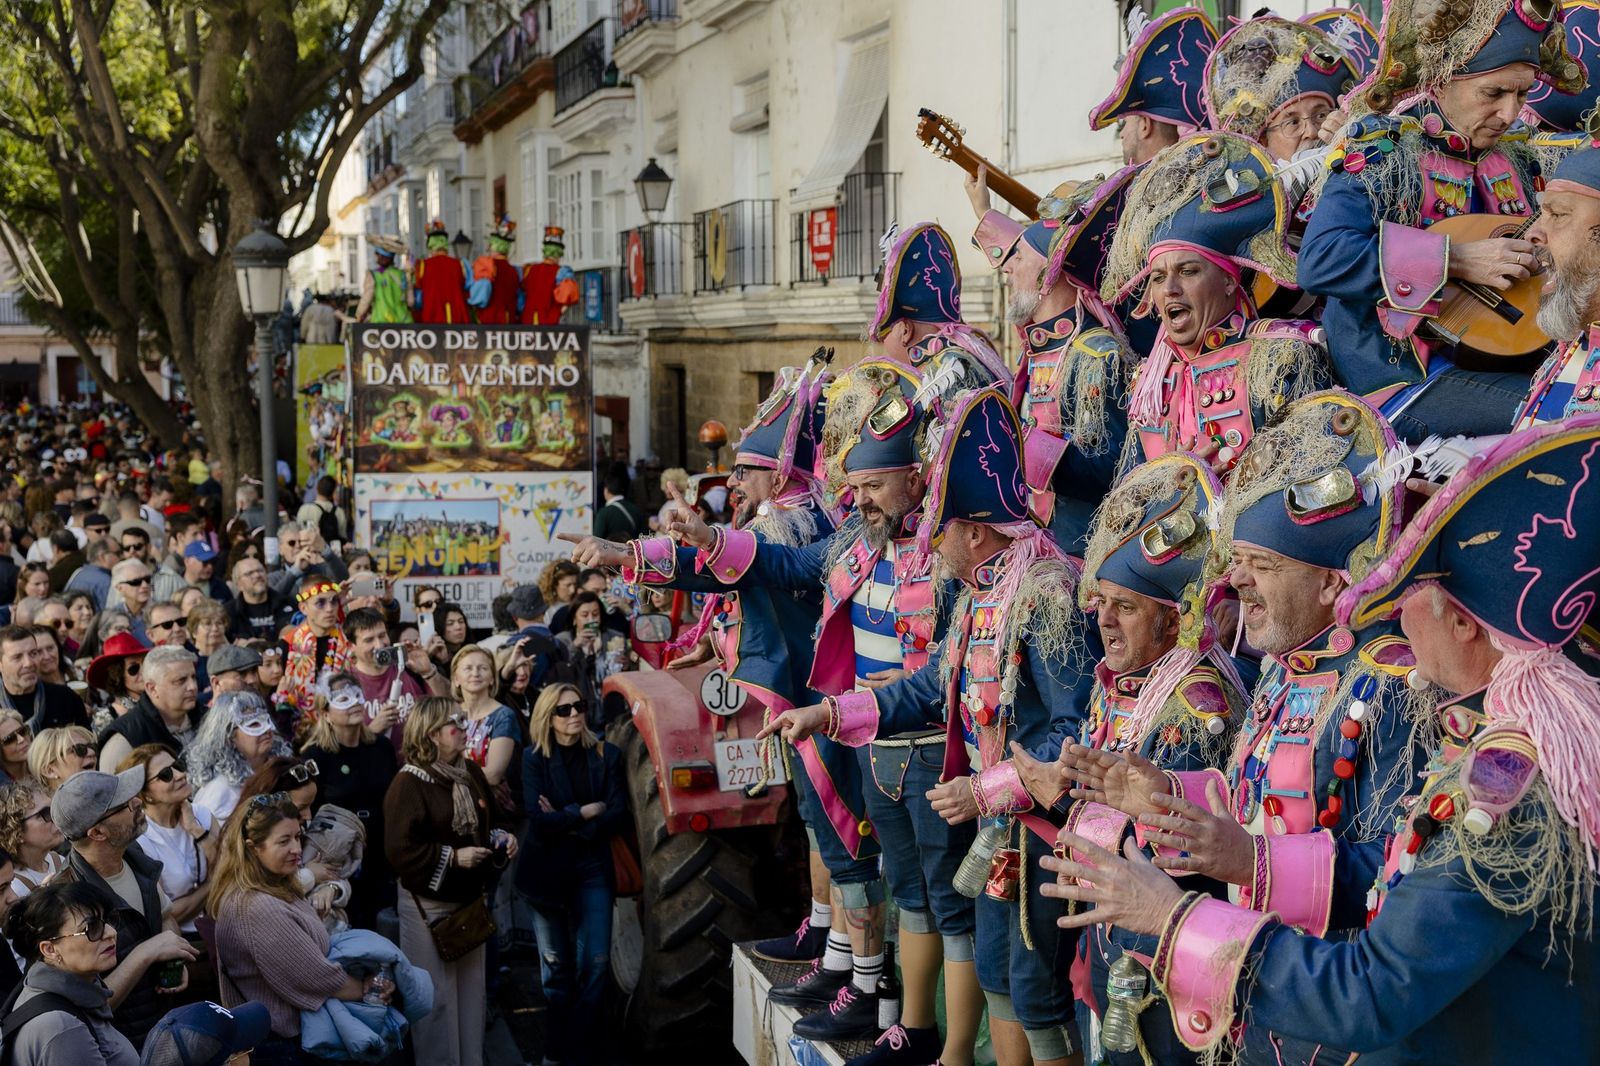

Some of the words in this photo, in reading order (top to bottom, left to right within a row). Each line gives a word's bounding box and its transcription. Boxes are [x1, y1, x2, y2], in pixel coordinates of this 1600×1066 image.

[362, 329, 437, 350] CORO
[445, 330, 479, 350] DE
[486, 331, 581, 351] HUELVA
[366, 362, 450, 386] DAME
[460, 364, 580, 386] VENENO
[467, 581, 486, 601] DE
[709, 673, 740, 709] 30
